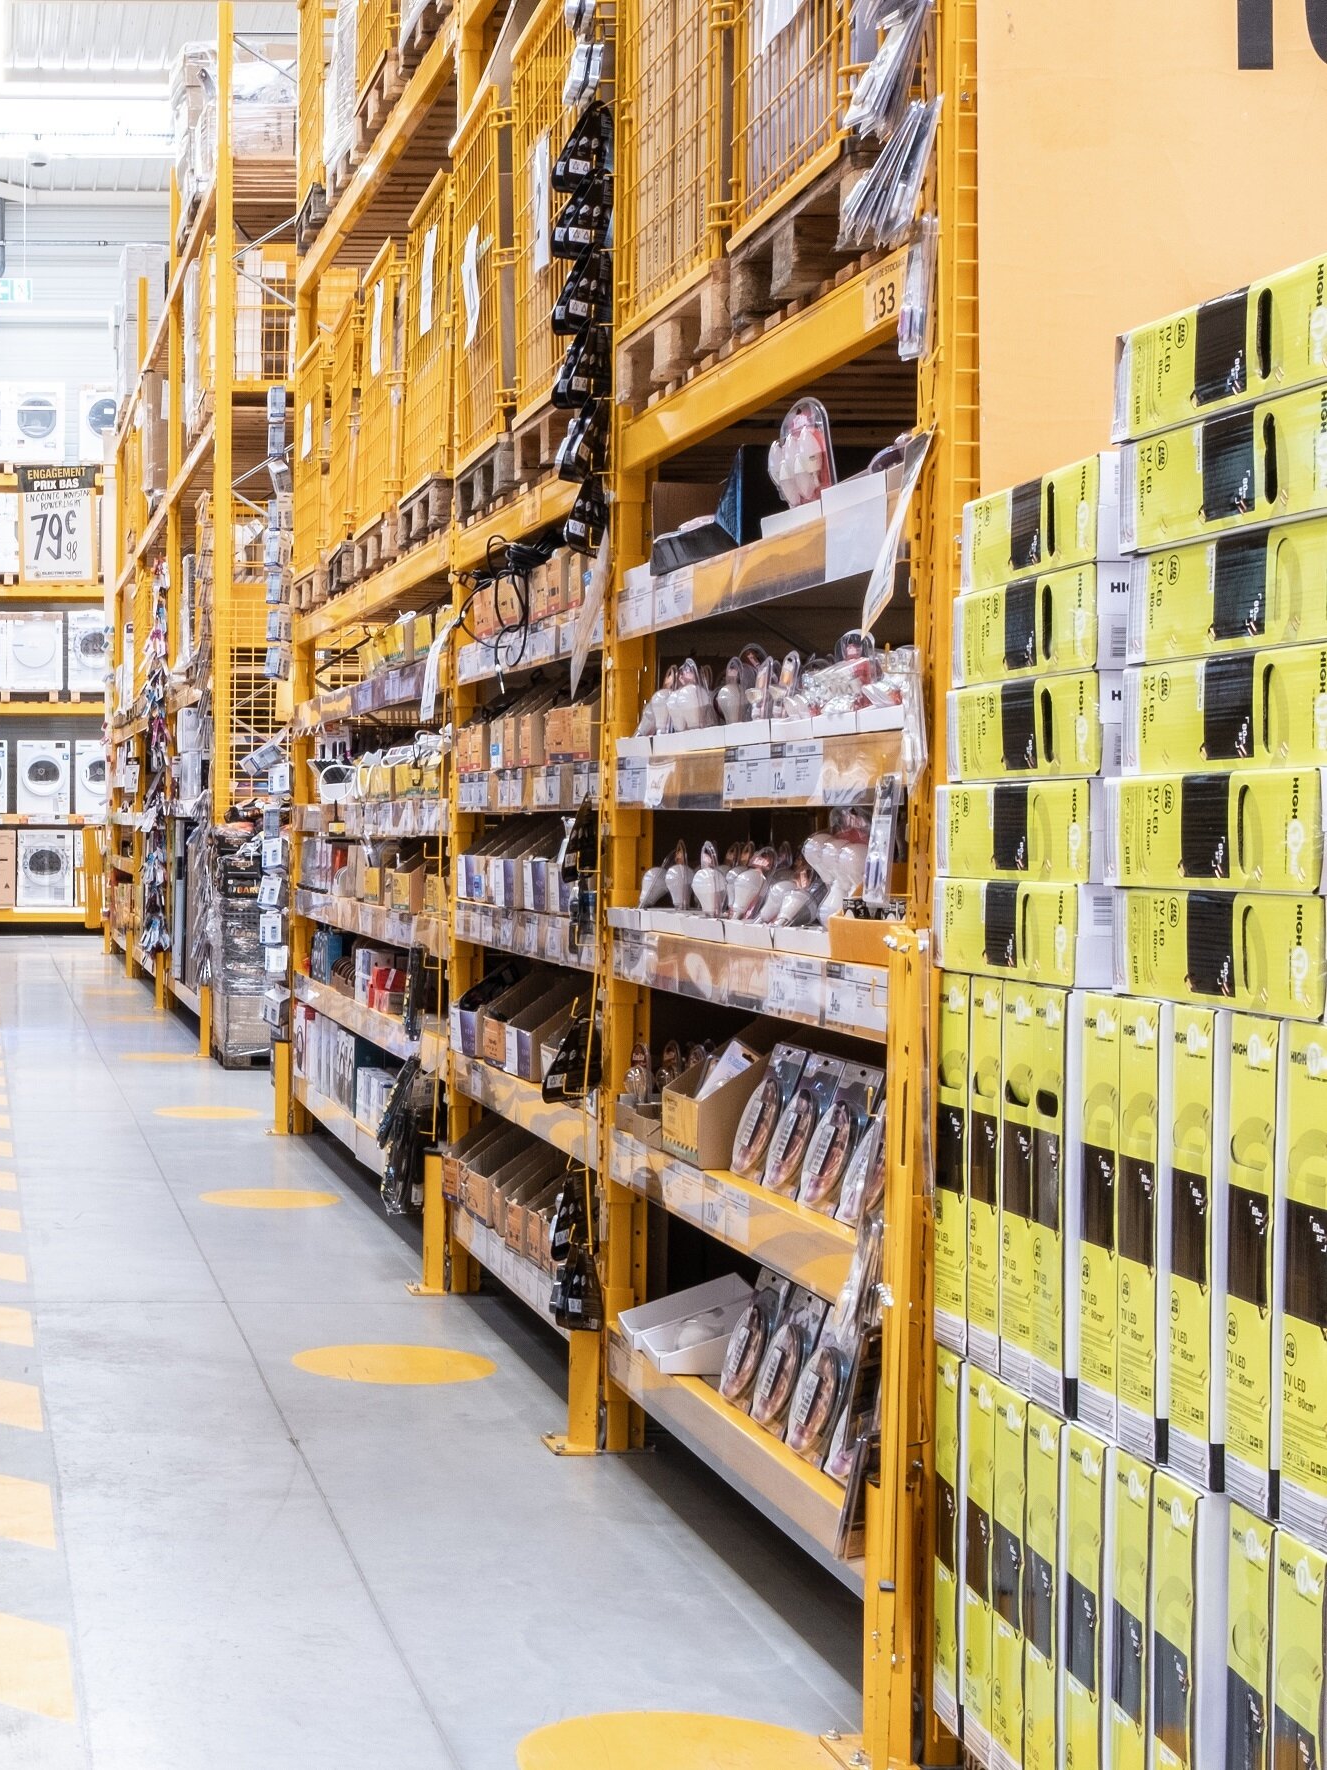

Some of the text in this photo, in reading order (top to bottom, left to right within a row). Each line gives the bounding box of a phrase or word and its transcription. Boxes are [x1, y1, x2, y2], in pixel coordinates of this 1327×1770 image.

[1316, 264, 1325, 307] HIGH
[873, 282, 895, 322] 133
[1165, 325, 1172, 340] TV
[1146, 446, 1152, 463] TV
[27, 467, 86, 480] ENGAGEMENT
[33, 479, 79, 491] PRIX BAS
[31, 513, 63, 560] 79
[65, 541, 77, 561] 98
[1158, 560, 1164, 577] TV
[1150, 675, 1155, 692] TV
[1153, 787, 1159, 804] TV
[1159, 898, 1165, 916] TV
[1006, 1003, 1016, 1014] HIGH
[1036, 1008, 1046, 1017] HIGH
[1085, 1017, 1097, 1028] HIGH
[1123, 1025, 1135, 1036] HIGH
[1175, 1031, 1187, 1044] HIGH
[1232, 1042, 1248, 1055] HIGH
[1291, 1052, 1307, 1065] HIGH
[1003, 1256, 1008, 1267] TV
[1034, 1270, 1039, 1281] TV
[1081, 1289, 1097, 1306] TV LED
[1121, 1308, 1137, 1325] TV LED
[1170, 1326, 1187, 1345] TV LED
[1226, 1350, 1245, 1370] TV LED
[1284, 1371, 1306, 1393] TV LED
[997, 1406, 1007, 1417] HIGH
[1070, 1449, 1082, 1464] HIGH
[1117, 1469, 1129, 1488] HIGH
[1157, 1497, 1171, 1513] HIGH
[1280, 1558, 1296, 1579] HIGH
